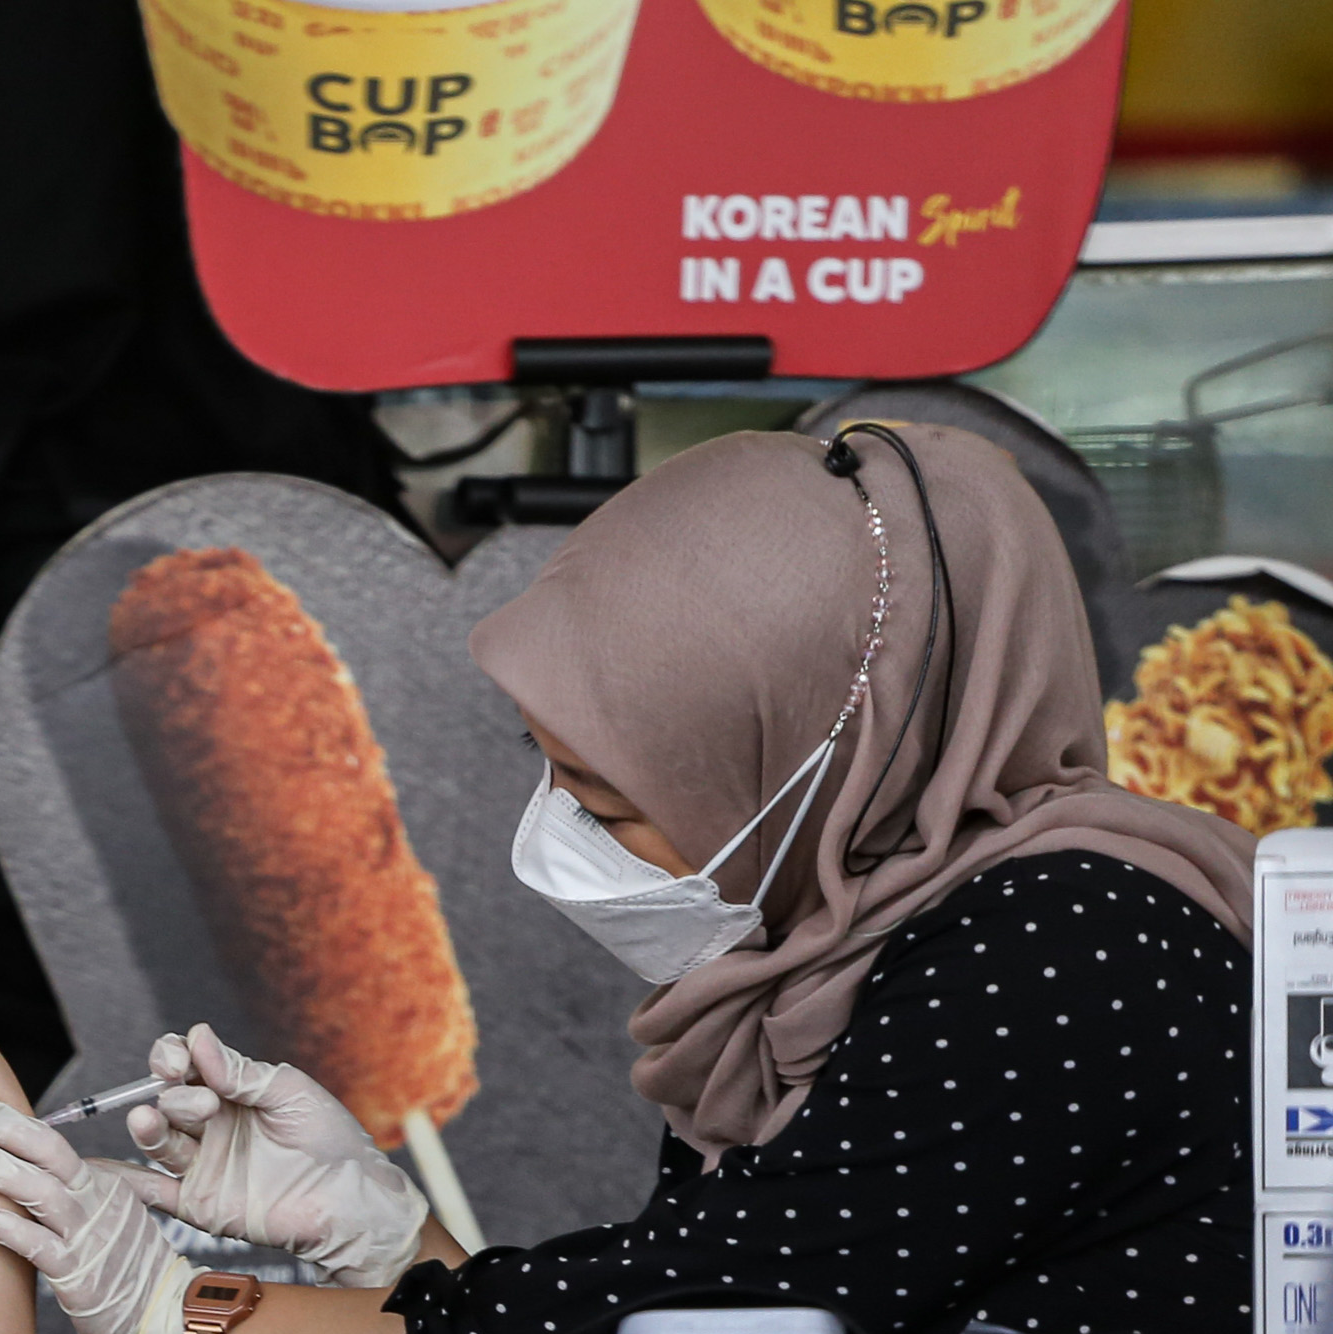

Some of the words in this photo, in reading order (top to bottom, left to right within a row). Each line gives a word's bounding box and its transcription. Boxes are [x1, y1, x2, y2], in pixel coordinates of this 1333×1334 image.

[304, 73, 473, 116] CUP
[681, 195, 909, 240] KOREAN
[679, 257, 740, 302] IN
[752, 257, 796, 302] A
[807, 257, 924, 304] CUP
